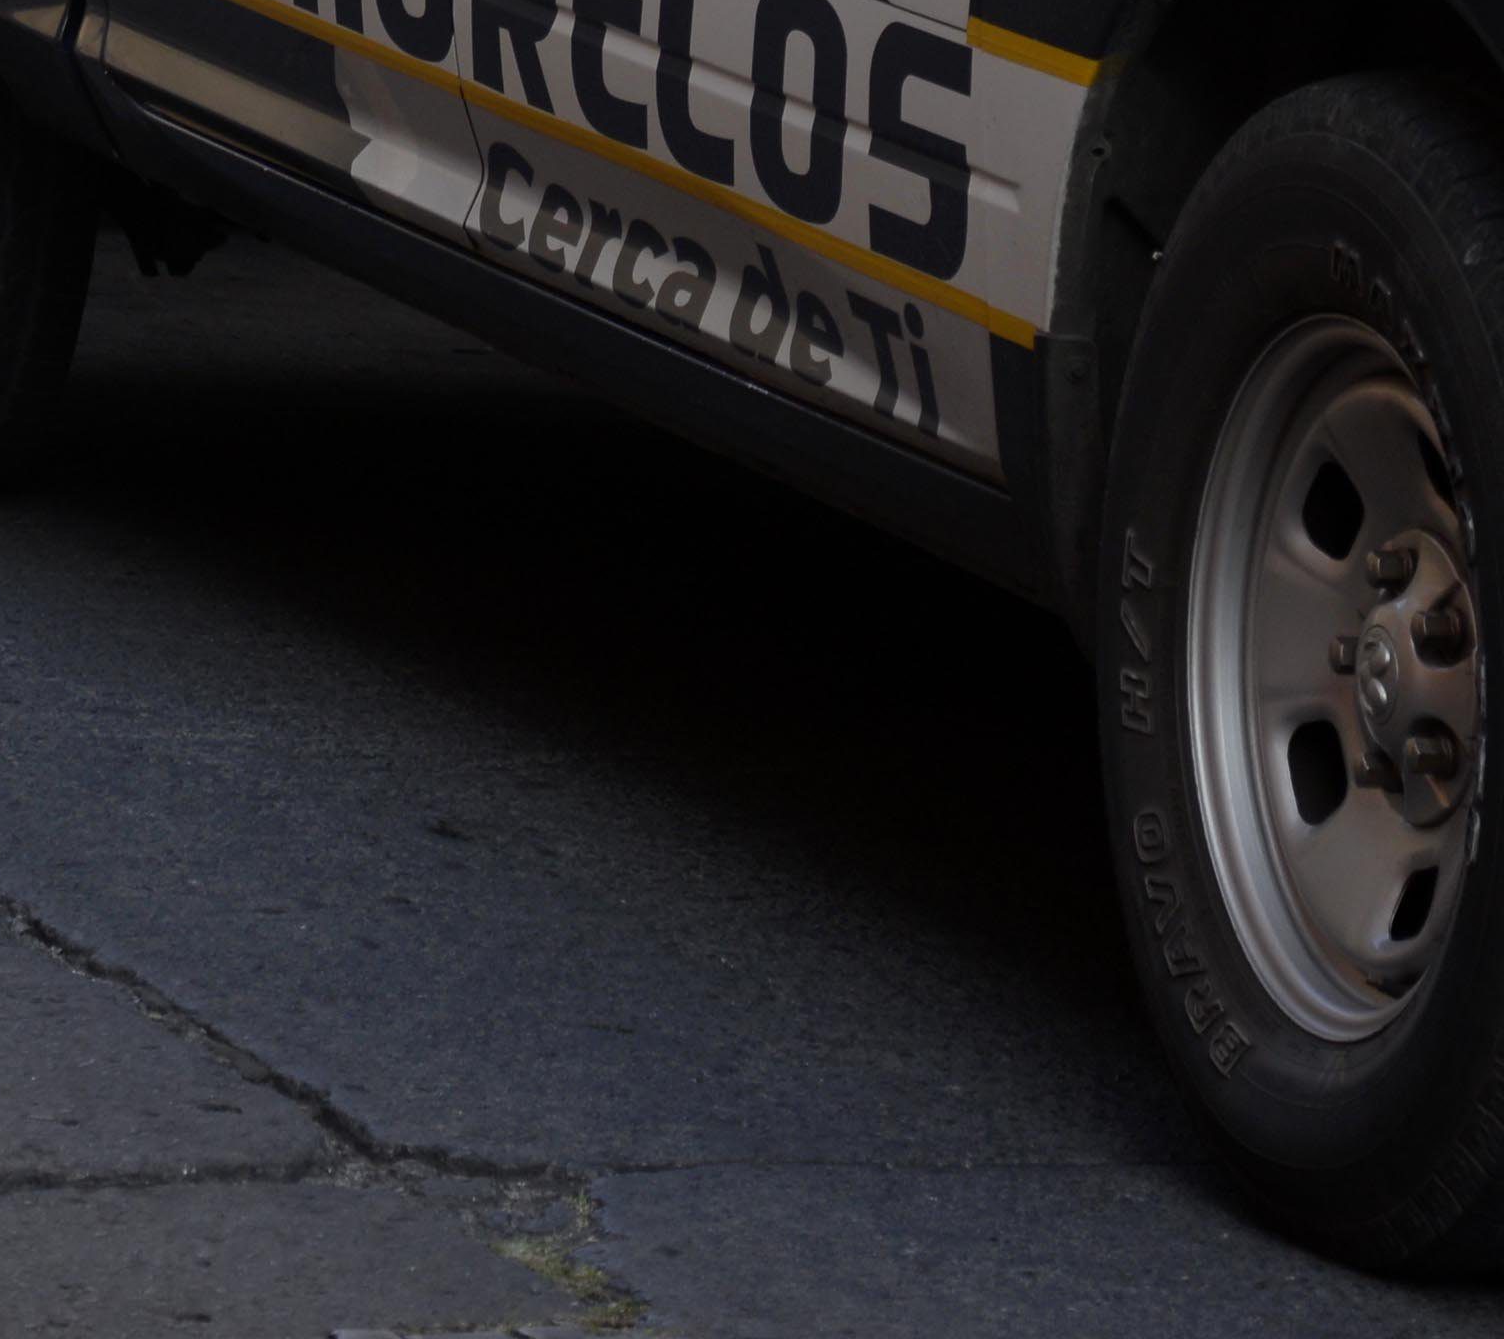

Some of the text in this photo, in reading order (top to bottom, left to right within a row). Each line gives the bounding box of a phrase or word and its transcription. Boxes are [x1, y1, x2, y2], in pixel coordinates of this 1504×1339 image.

[728, 243, 845, 388] de
[845, 290, 940, 437] Ti
[1132, 809, 1253, 1080] BRAVO
